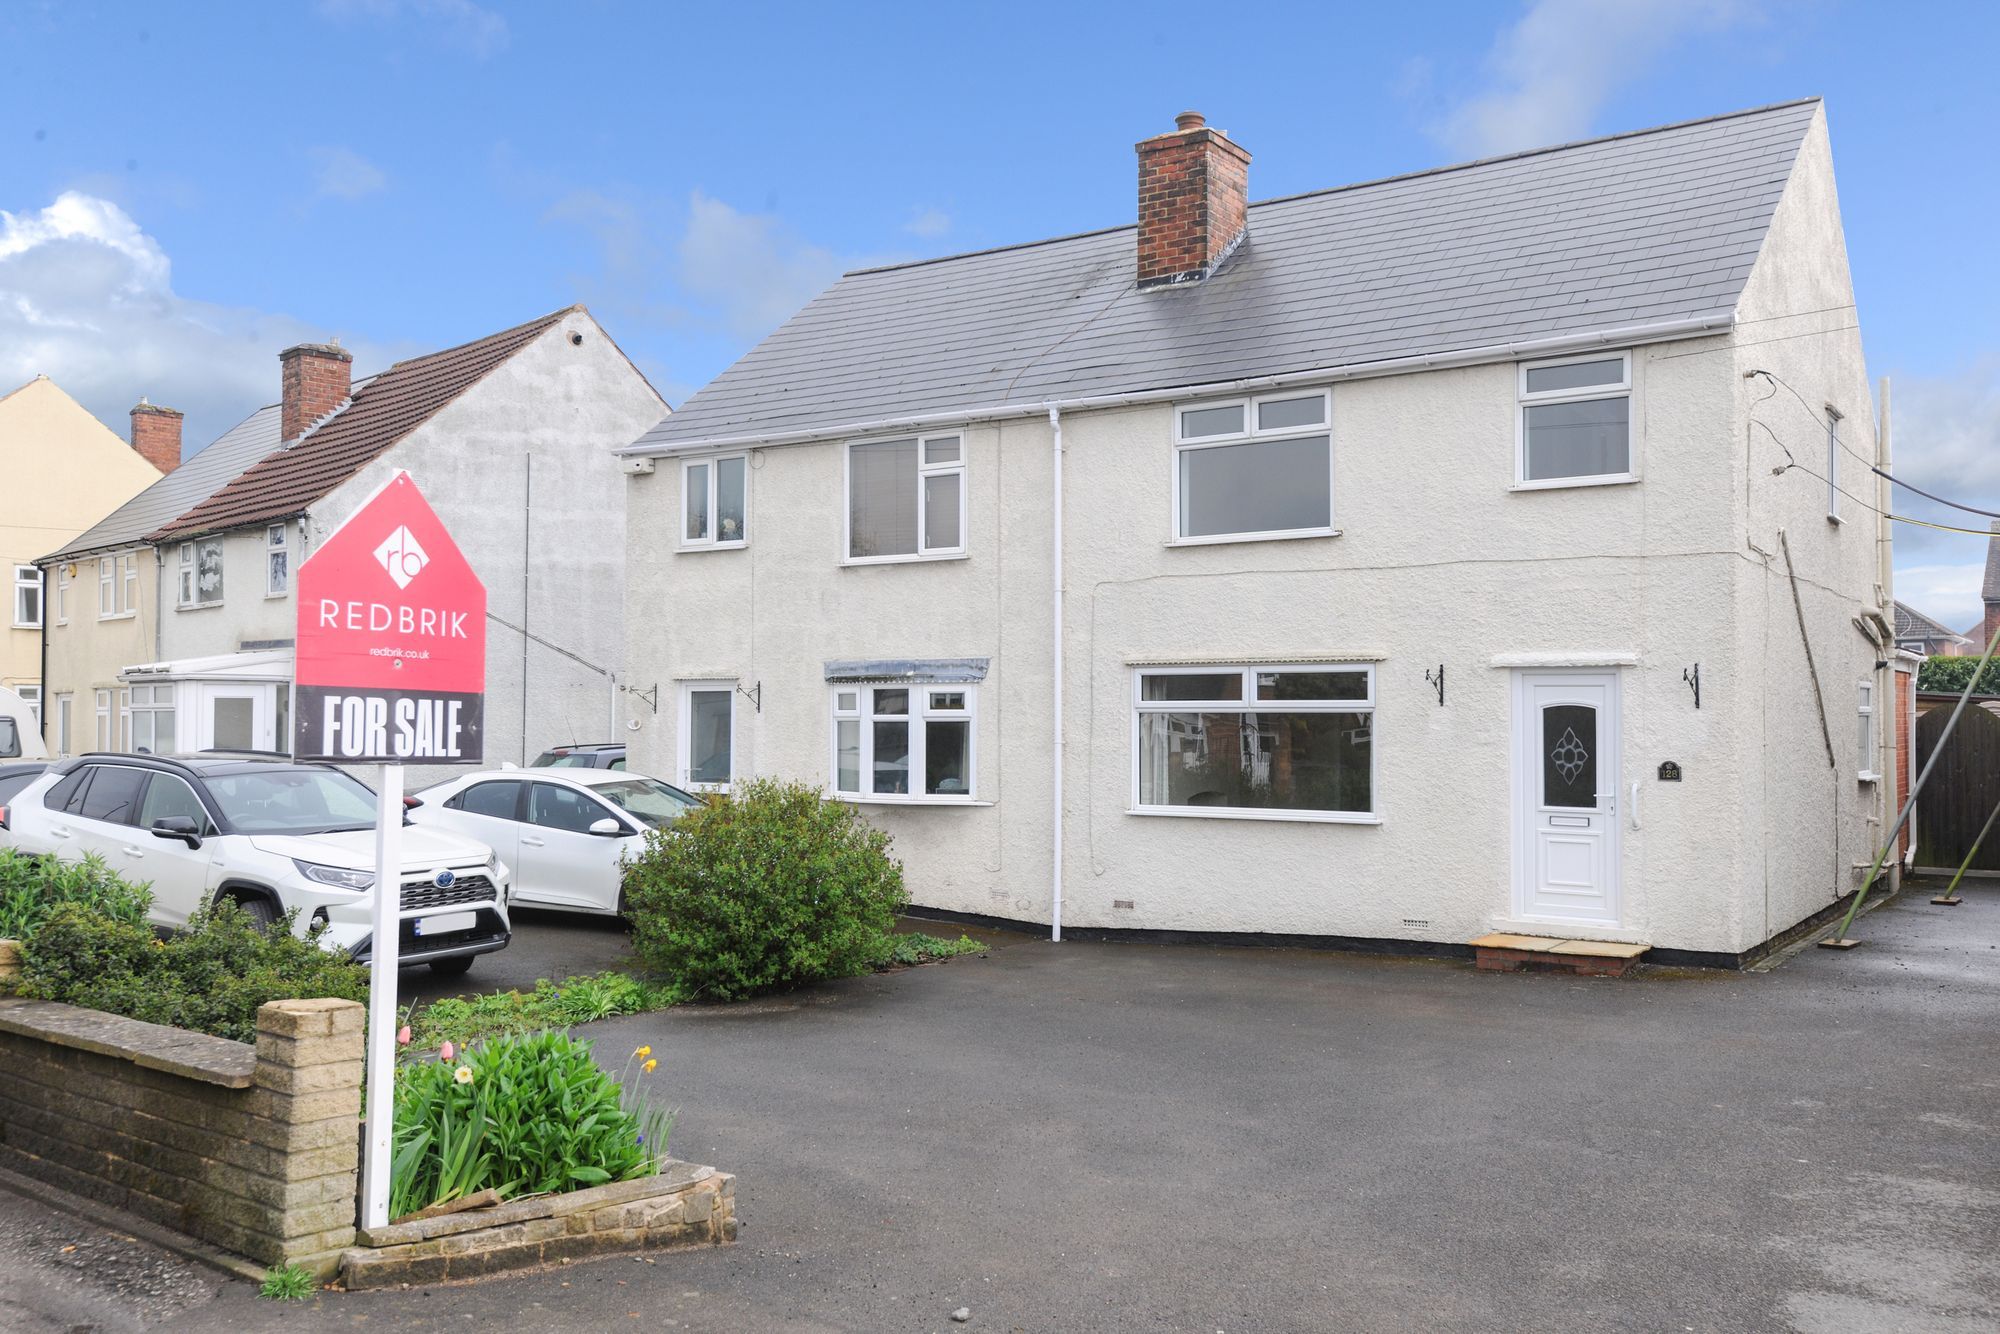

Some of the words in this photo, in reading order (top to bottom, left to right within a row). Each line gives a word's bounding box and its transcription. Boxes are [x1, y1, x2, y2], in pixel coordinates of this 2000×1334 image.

[320, 599, 468, 639] REDBRIK
[369, 647, 430, 660] redbrik.co.uk
[323, 695, 388, 757] FOR
[394, 697, 462, 757] SALE
[1662, 770, 1678, 778] 128
